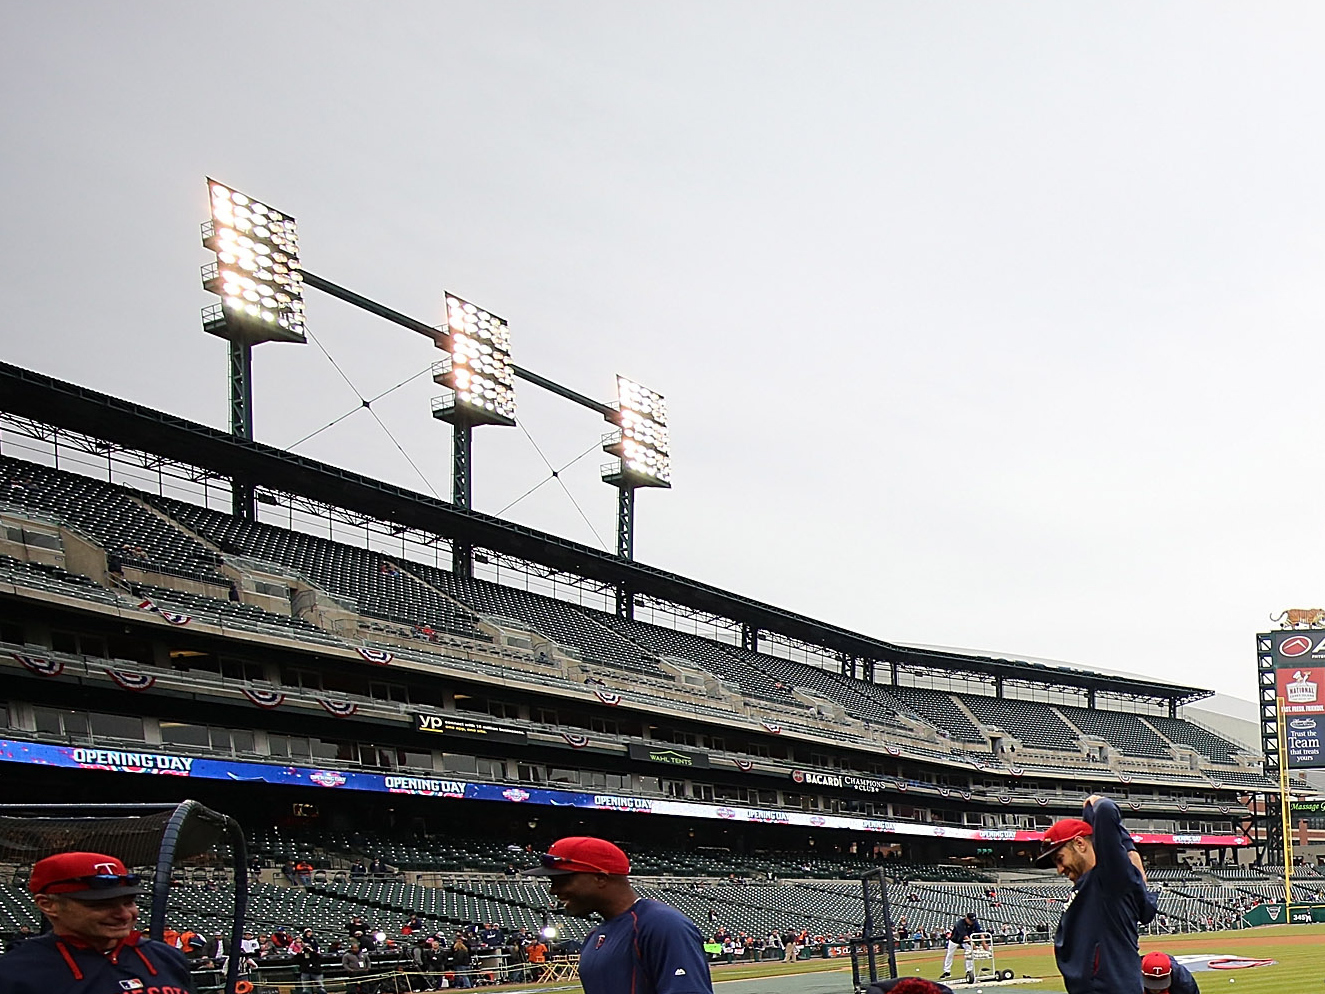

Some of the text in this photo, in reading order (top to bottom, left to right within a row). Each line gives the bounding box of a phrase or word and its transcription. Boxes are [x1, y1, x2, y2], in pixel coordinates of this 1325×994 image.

[1289, 686, 1315, 695] NATIONAL
[419, 714, 443, 729] yp
[1288, 736, 1320, 748] Team
[74, 748, 194, 772] OPENING DAY
[650, 754, 692, 766] WAHL TENTS
[384, 775, 467, 794] OPENING DAY
[844, 776, 886, 790] CHAMPIONS
[858, 784, 876, 793] CLUB
[594, 795, 653, 809] OPENING DAY
[1290, 802, 1320, 811] Massage
[746, 809, 775, 820] OPENING
